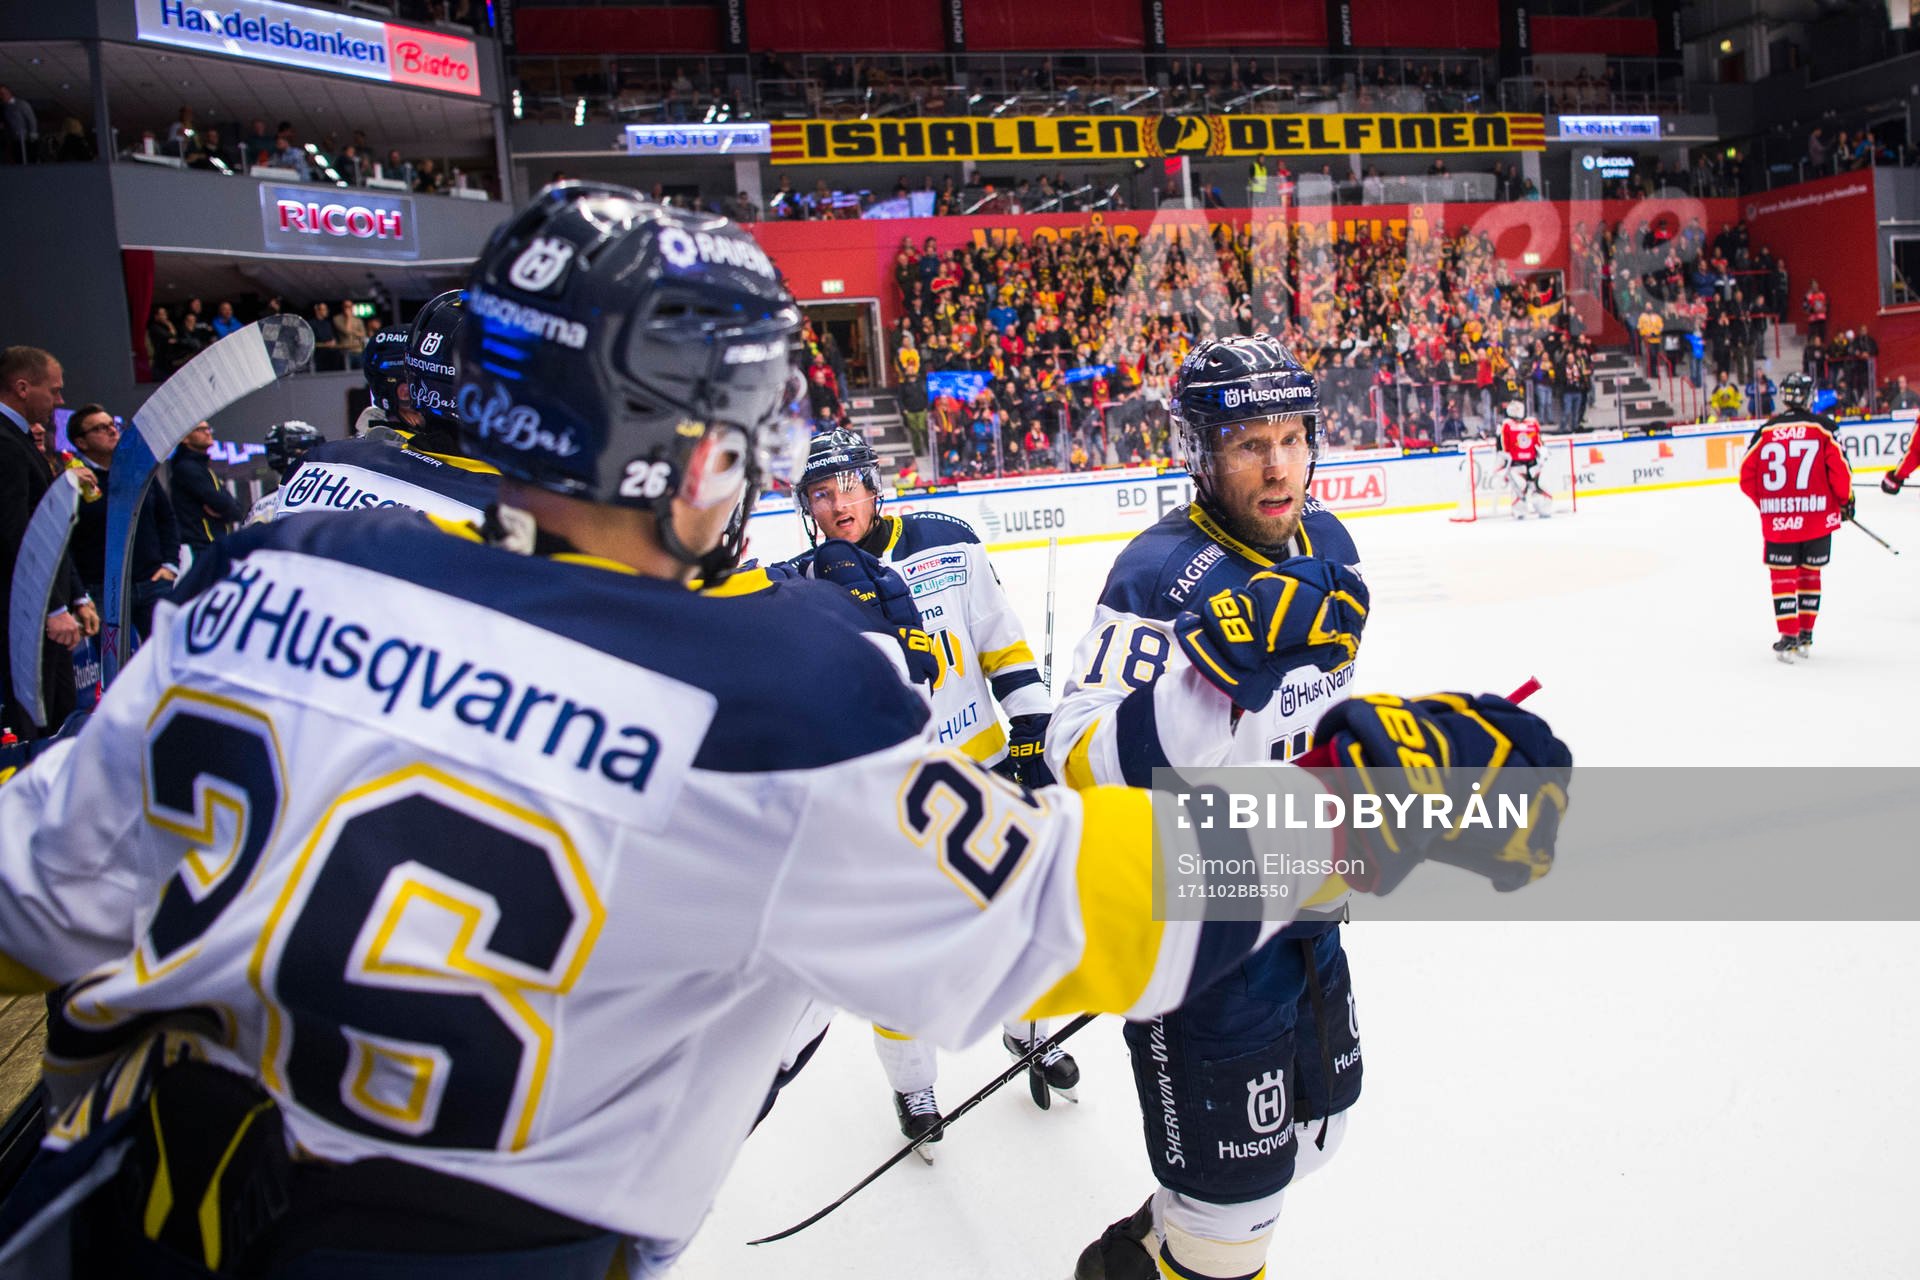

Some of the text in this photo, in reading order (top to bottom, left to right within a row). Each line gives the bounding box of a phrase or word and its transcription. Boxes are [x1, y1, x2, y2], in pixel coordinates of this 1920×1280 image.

[1153, 1, 1165, 44] PONTO
[1339, 4, 1352, 46] PONTO
[396, 40, 470, 82] Bistro
[806, 116, 1507, 158] ISHALLEN DELFINEN
[277, 199, 404, 240] RICOH
[1241, 386, 1312, 404] Husqvarna
[1772, 427, 1807, 442] SSAB
[620, 459, 672, 498] 26
[805, 453, 849, 471] Husqvarna
[1633, 466, 1665, 483] pwc
[1760, 439, 1820, 492] 37
[1116, 488, 1147, 508] BD
[1003, 507, 1066, 533] LULEBO
[1772, 516, 1804, 531] SSAB
[916, 555, 963, 573] INTERSPORT
[1082, 621, 1173, 692] 18
[234, 578, 661, 794] Husqvarna
[899, 750, 1047, 910] 2
[136, 685, 608, 1154] 26
